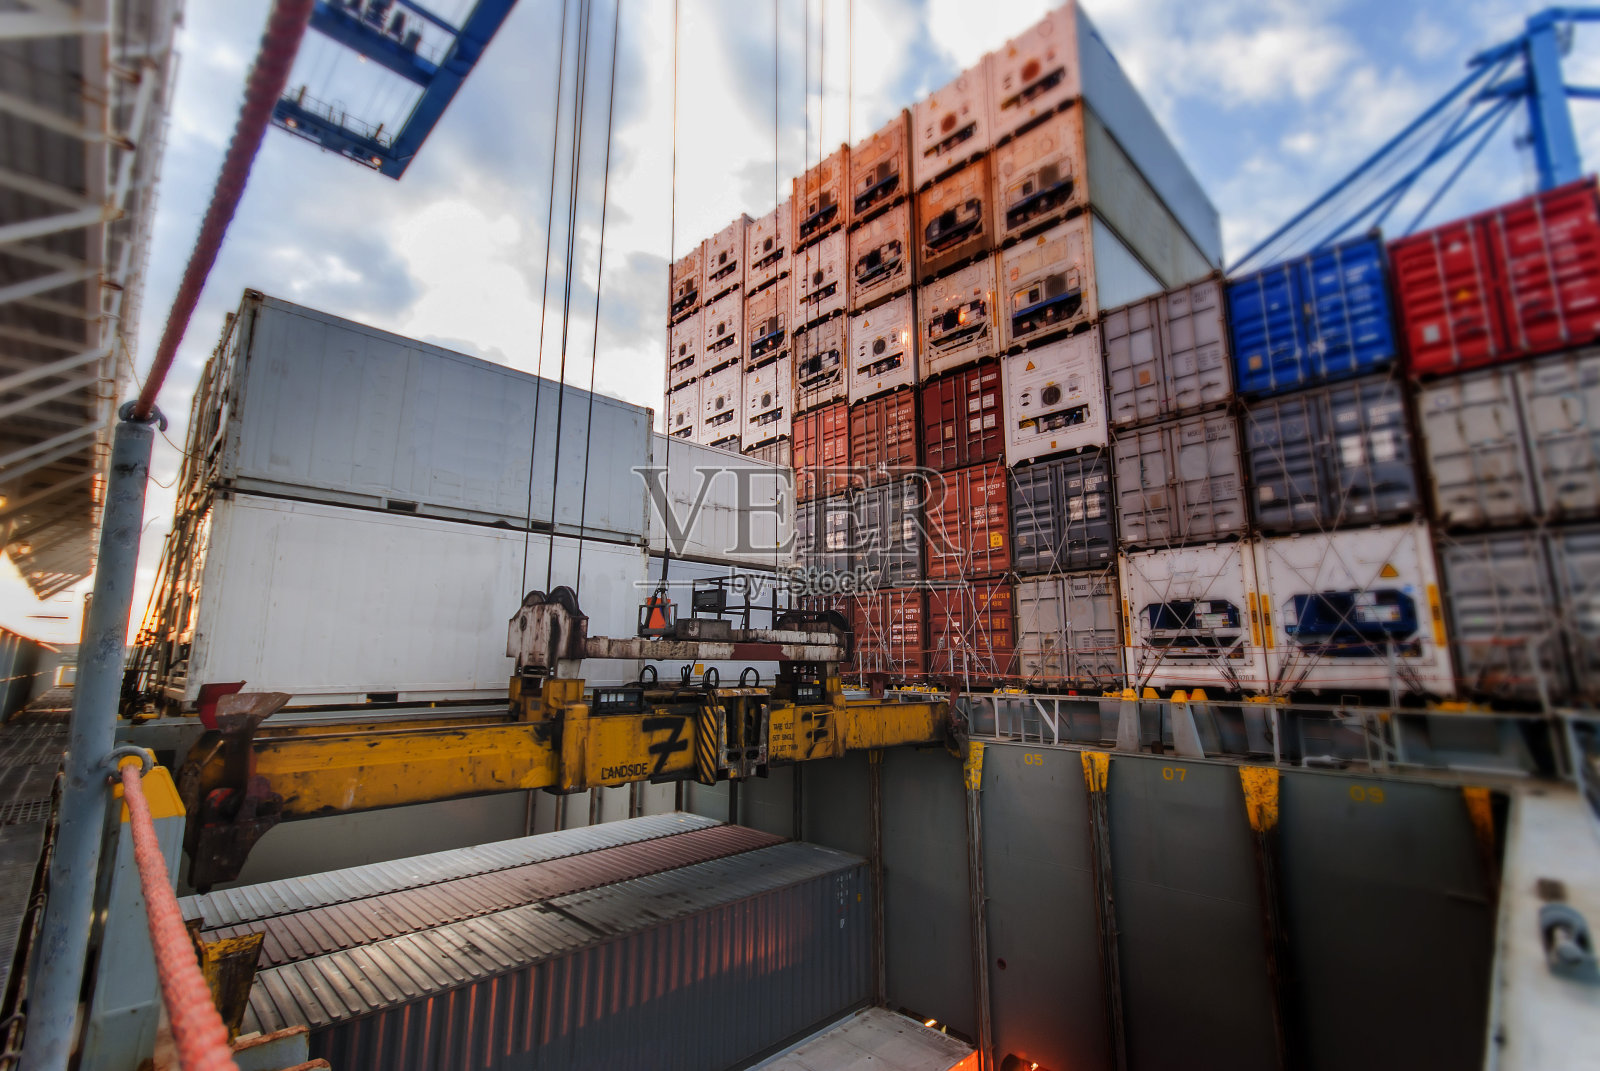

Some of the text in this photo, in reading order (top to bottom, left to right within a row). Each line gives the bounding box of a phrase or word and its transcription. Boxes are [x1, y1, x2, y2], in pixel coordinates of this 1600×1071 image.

[642, 717, 688, 774] 7
[1024, 753, 1043, 766] 05
[601, 762, 648, 780] LANDSIDE
[1162, 767, 1187, 782] 07
[1349, 784, 1385, 804] 09
